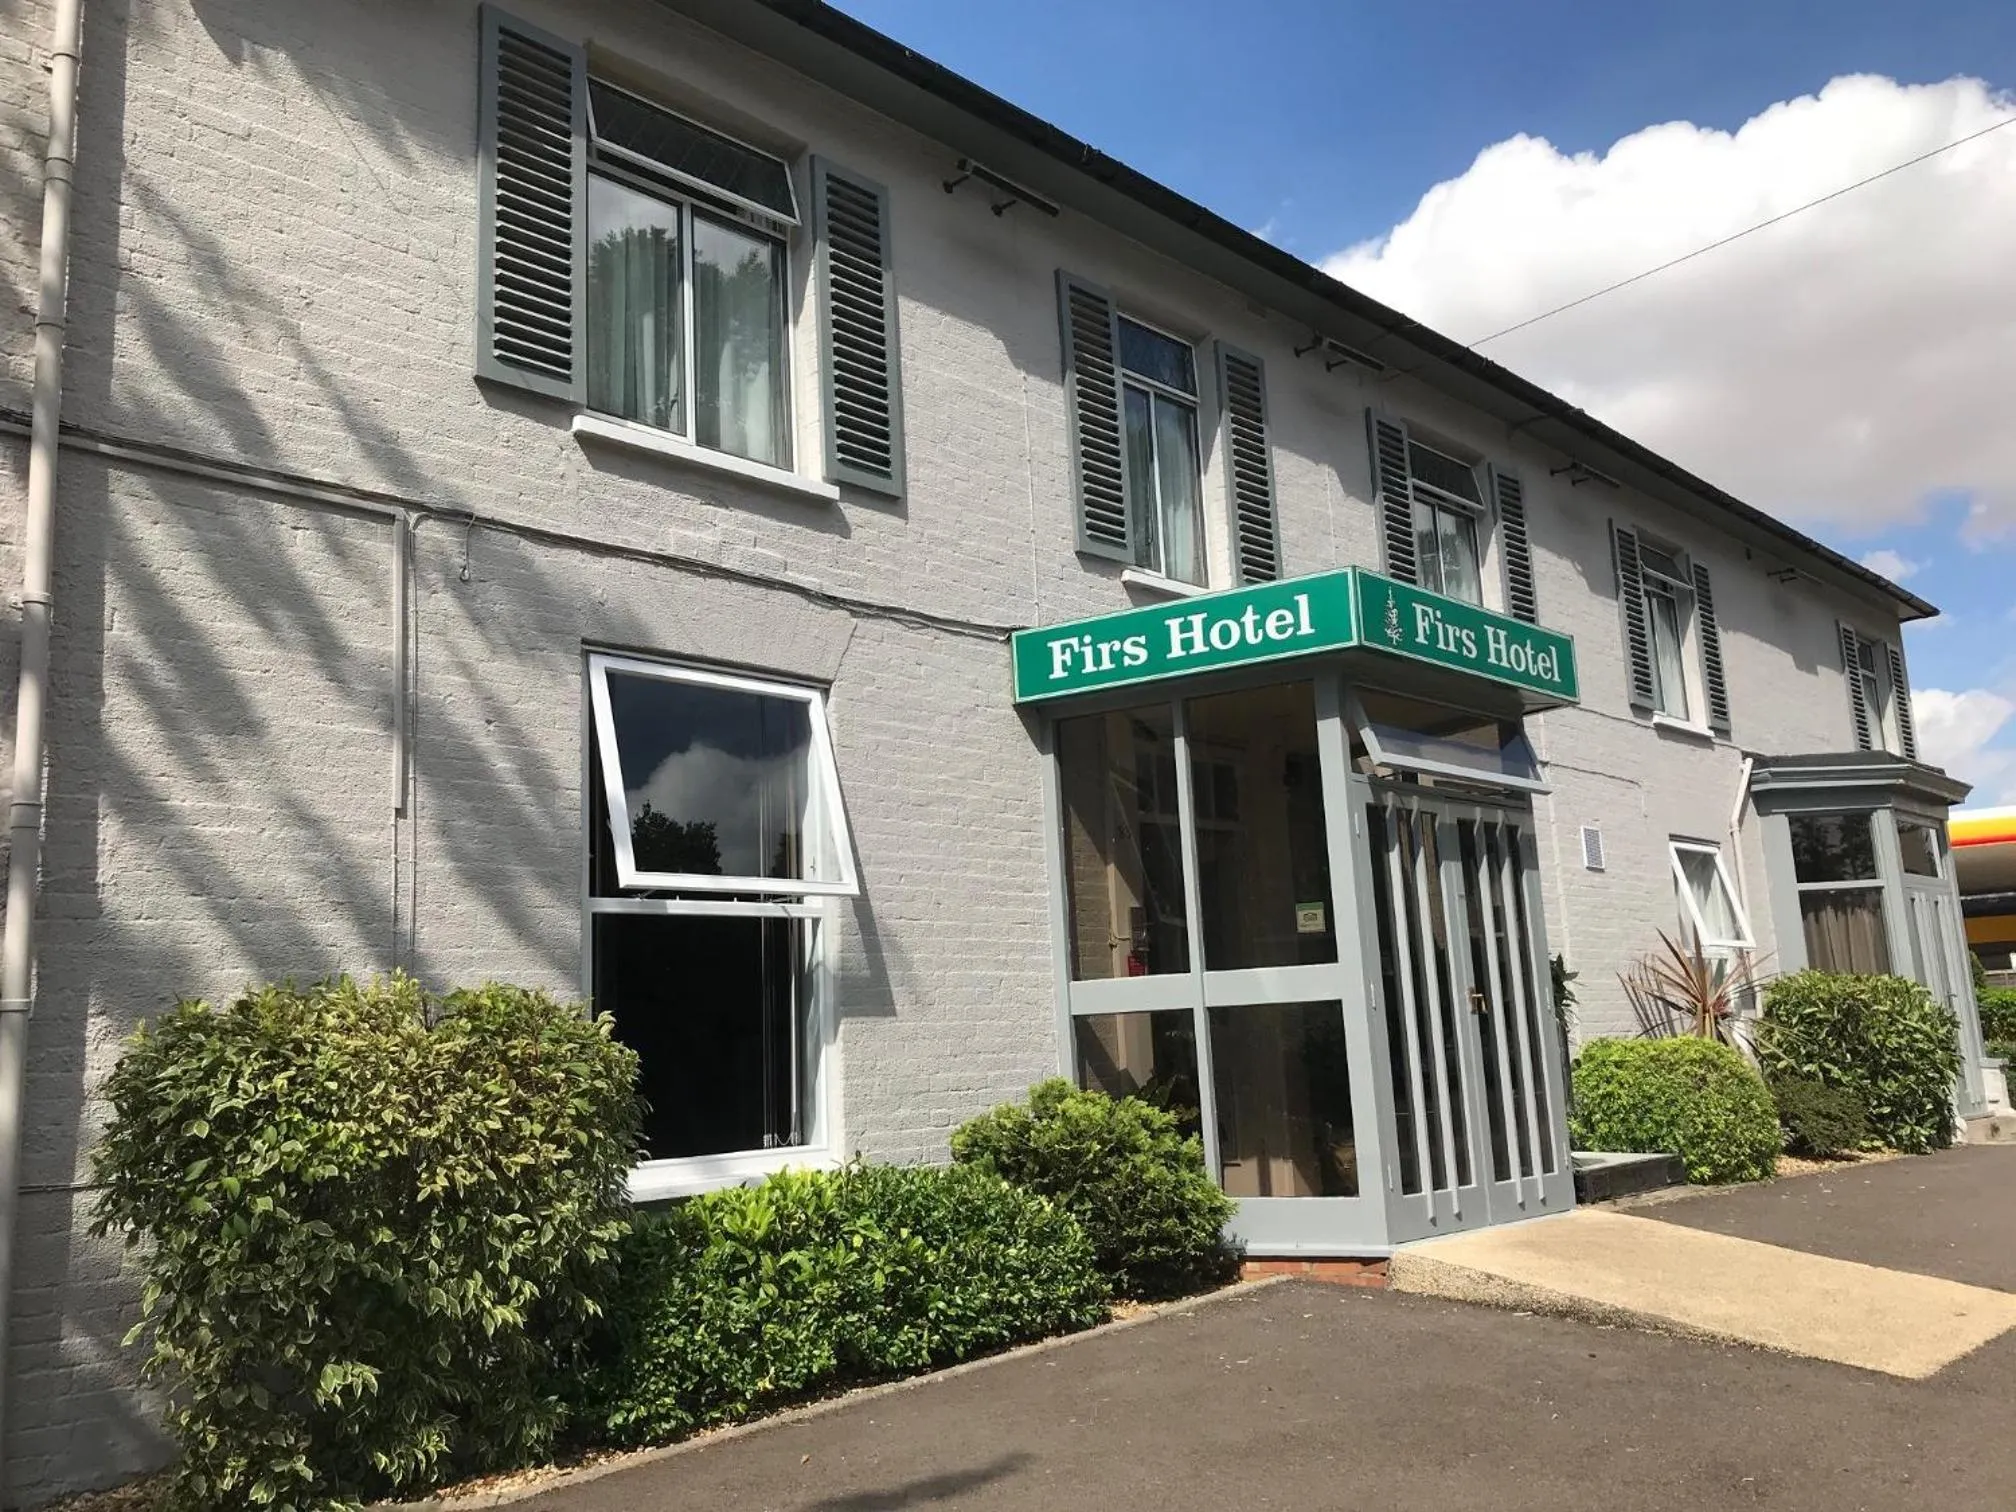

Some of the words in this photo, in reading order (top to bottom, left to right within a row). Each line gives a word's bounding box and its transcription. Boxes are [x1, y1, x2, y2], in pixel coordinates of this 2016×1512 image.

[1047, 635, 1148, 679] Firs
[1164, 593, 1315, 659] Hotel
[1412, 602, 1478, 658] Firs
[1485, 625, 1561, 683] Hotel
